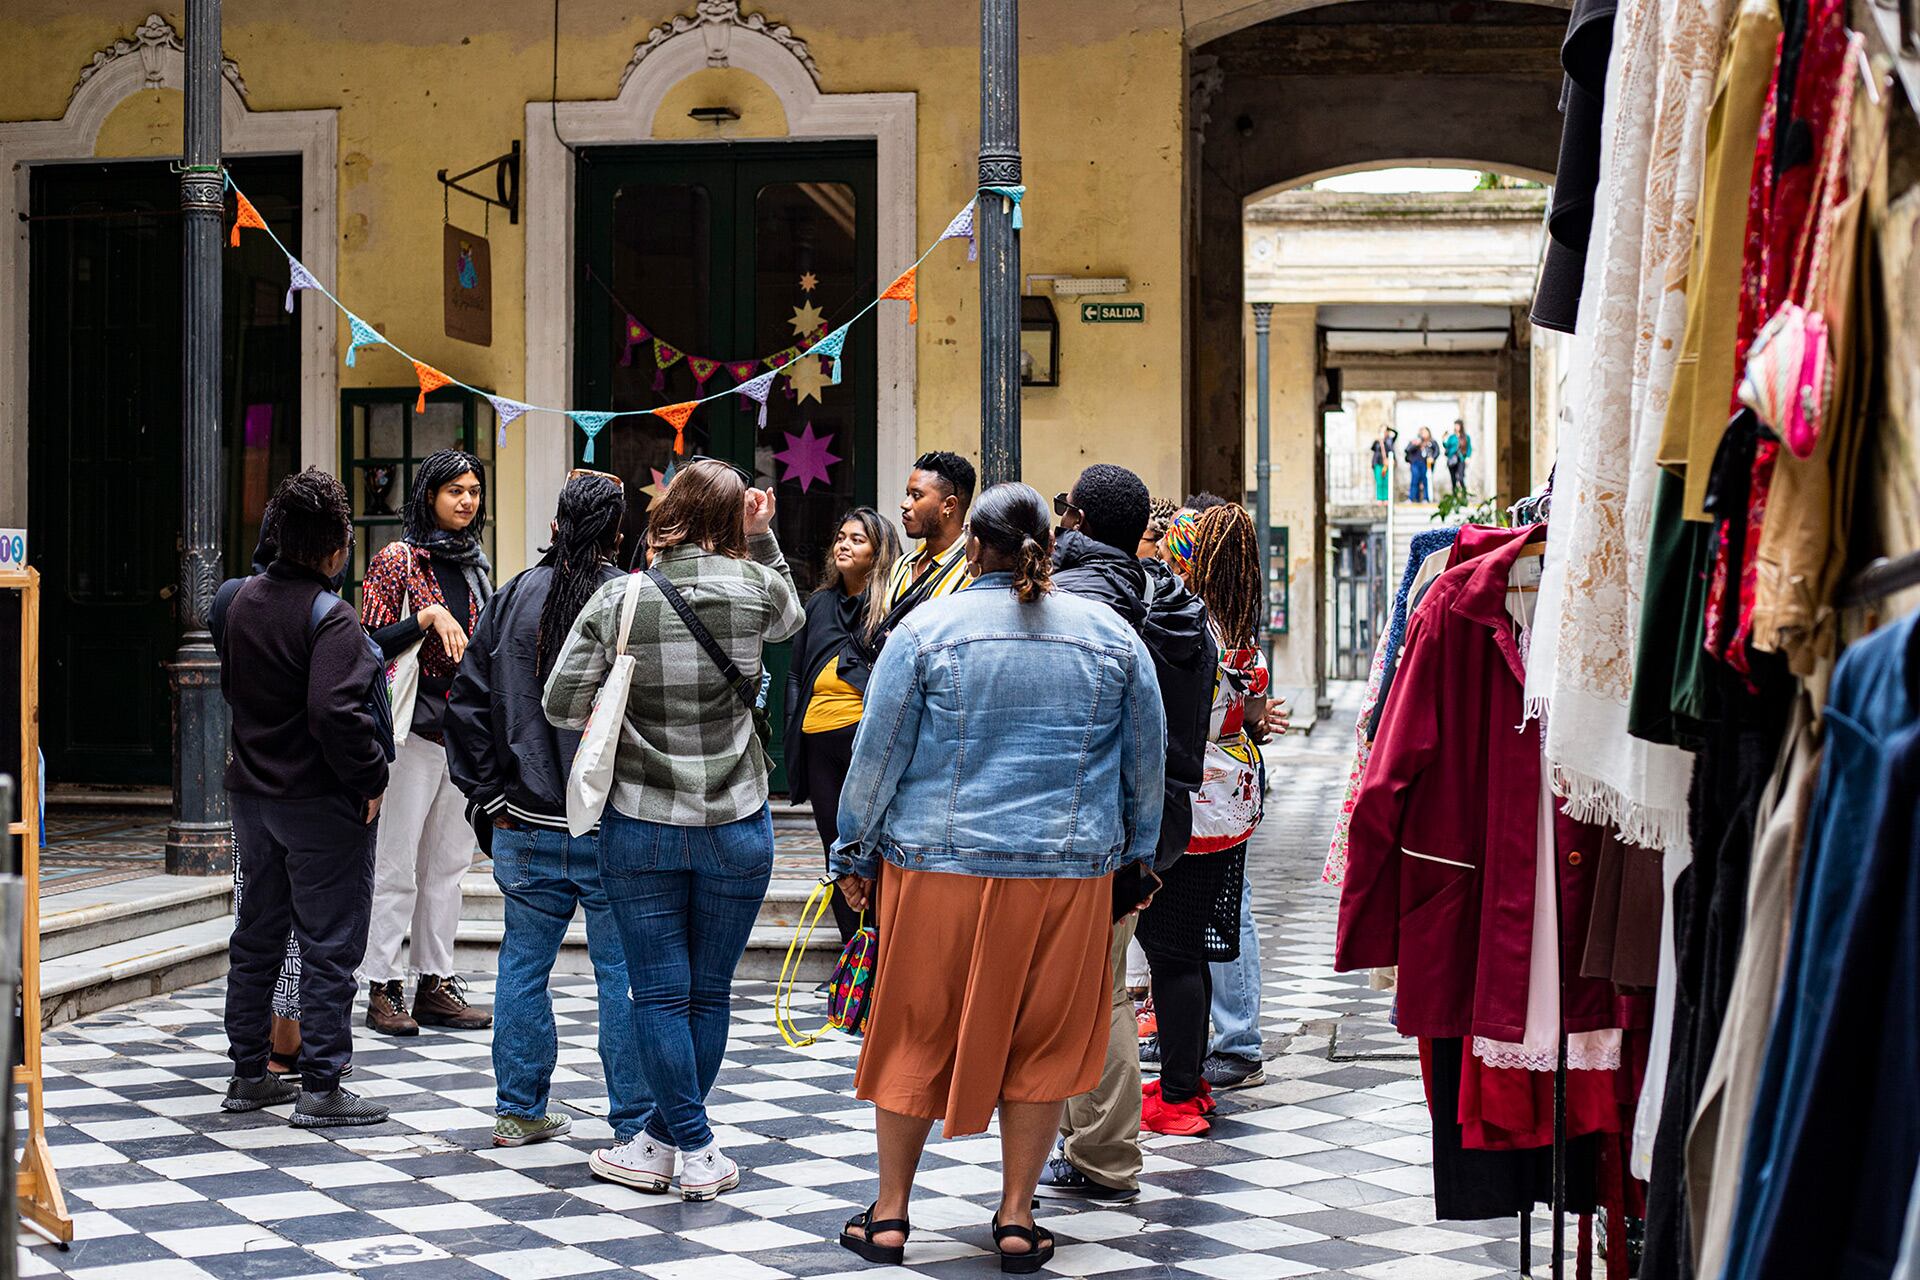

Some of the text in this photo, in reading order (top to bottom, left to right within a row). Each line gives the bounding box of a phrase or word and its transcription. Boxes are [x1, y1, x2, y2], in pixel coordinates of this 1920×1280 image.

[1102, 307, 1141, 319] SALIDA
[657, 577, 713, 648] BAGGU BAGGU
